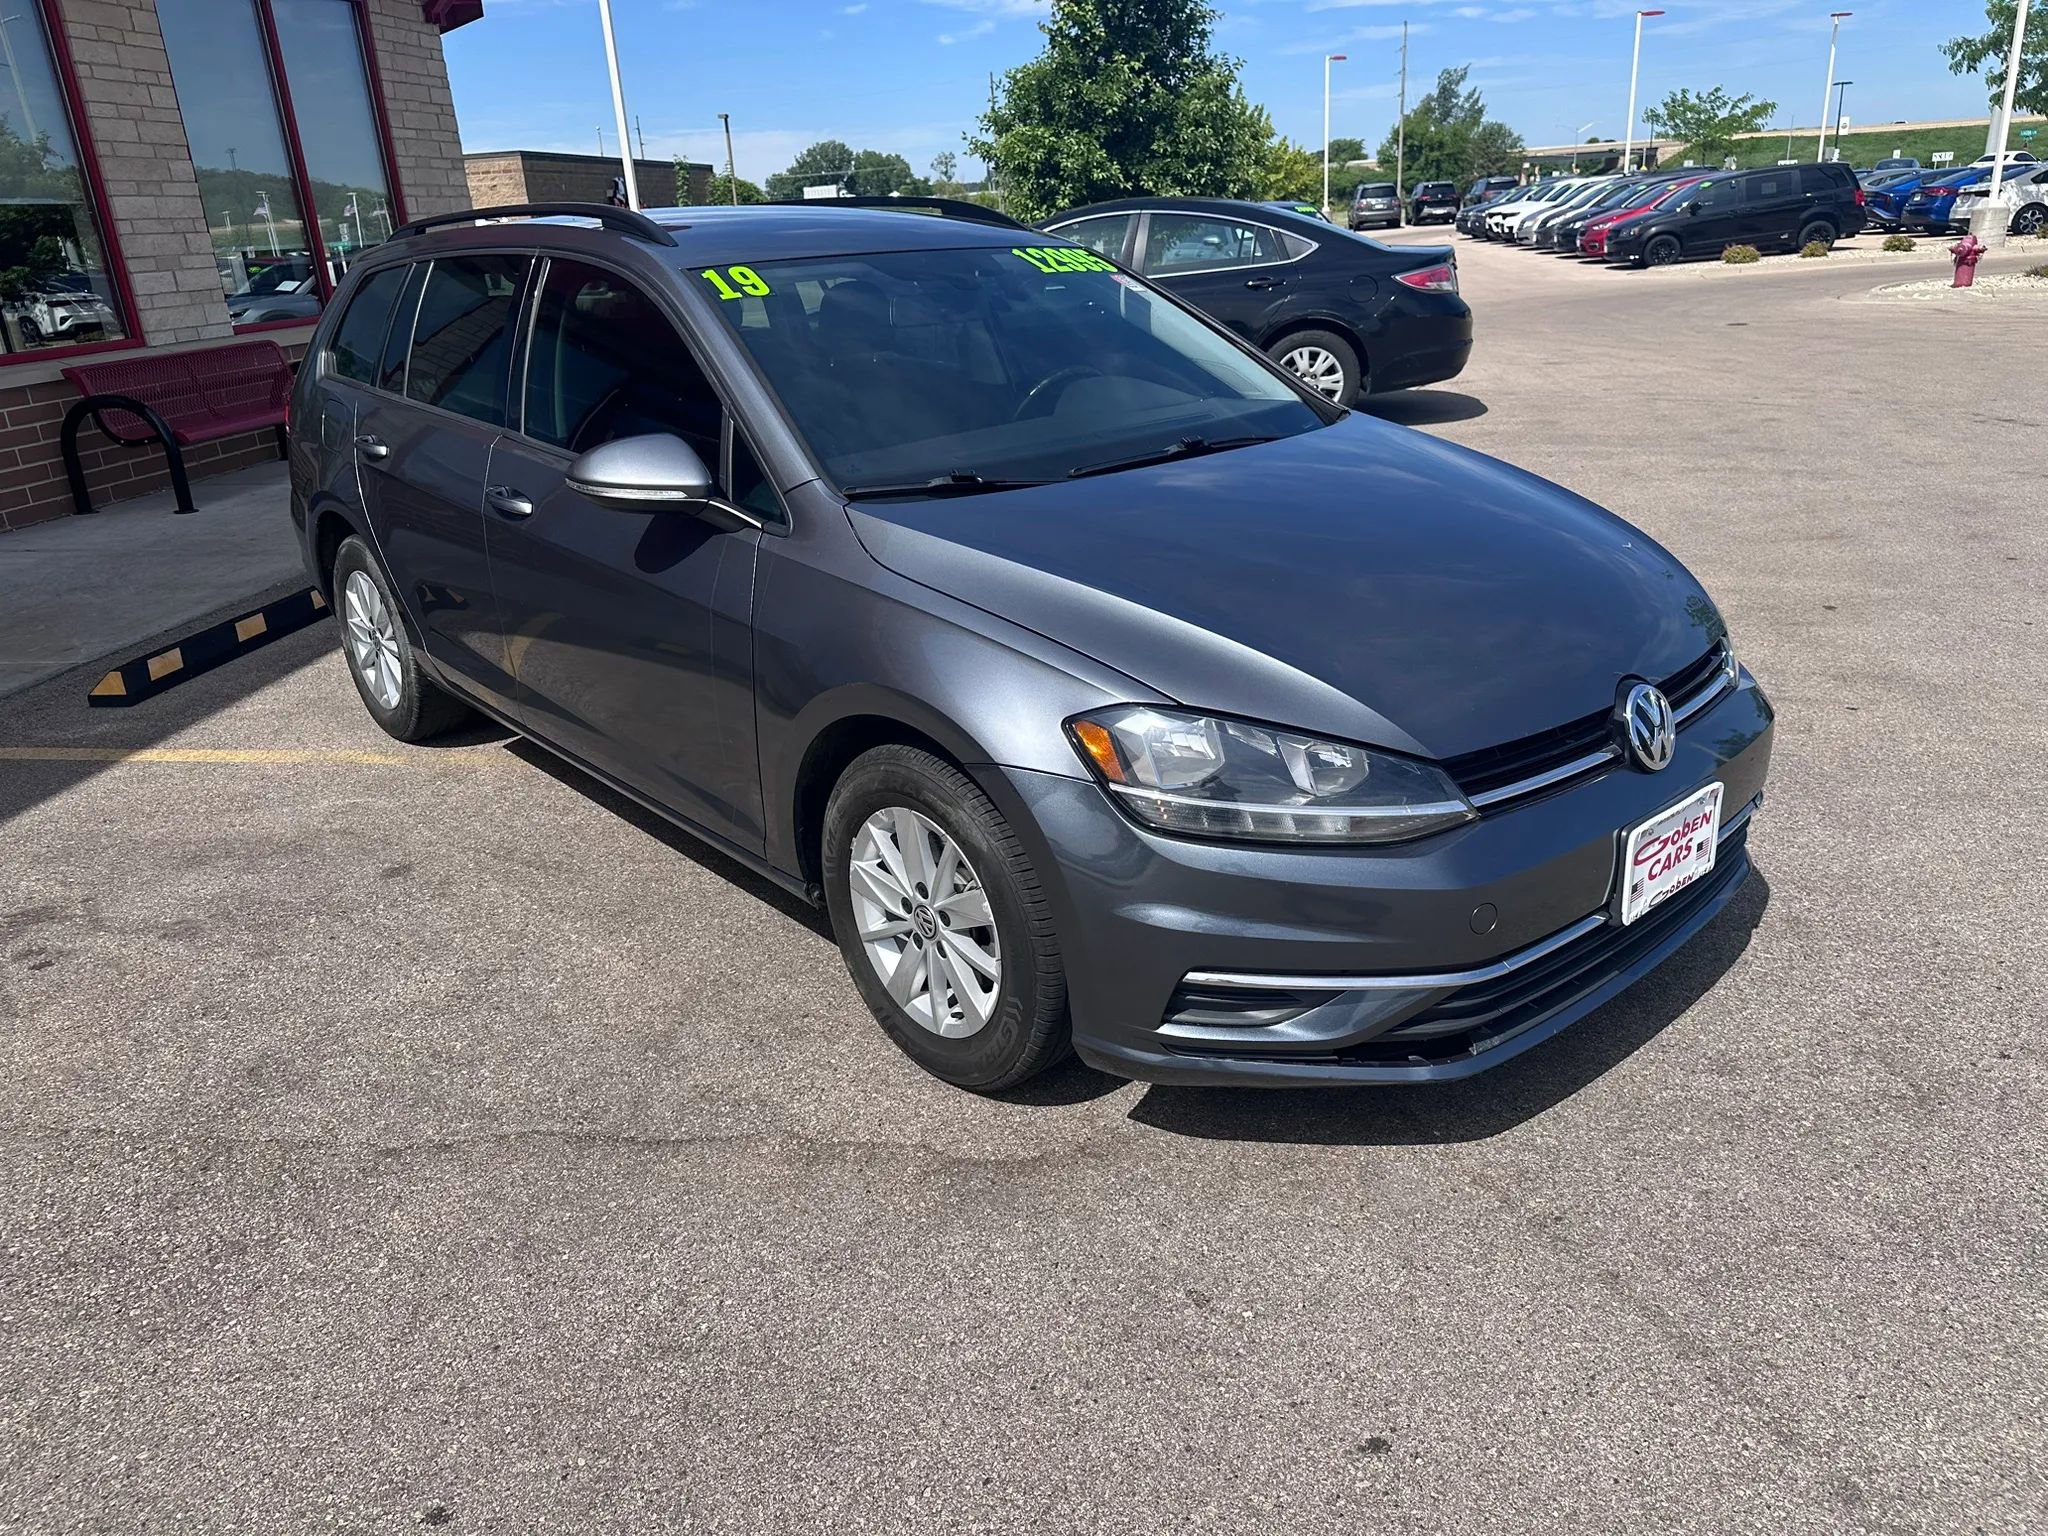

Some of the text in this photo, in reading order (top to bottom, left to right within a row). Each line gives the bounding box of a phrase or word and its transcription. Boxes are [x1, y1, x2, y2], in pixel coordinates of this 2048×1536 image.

[1012, 247, 1118, 273] 12995
[701, 265, 770, 300] 19
[1648, 837, 1694, 881] CARS
